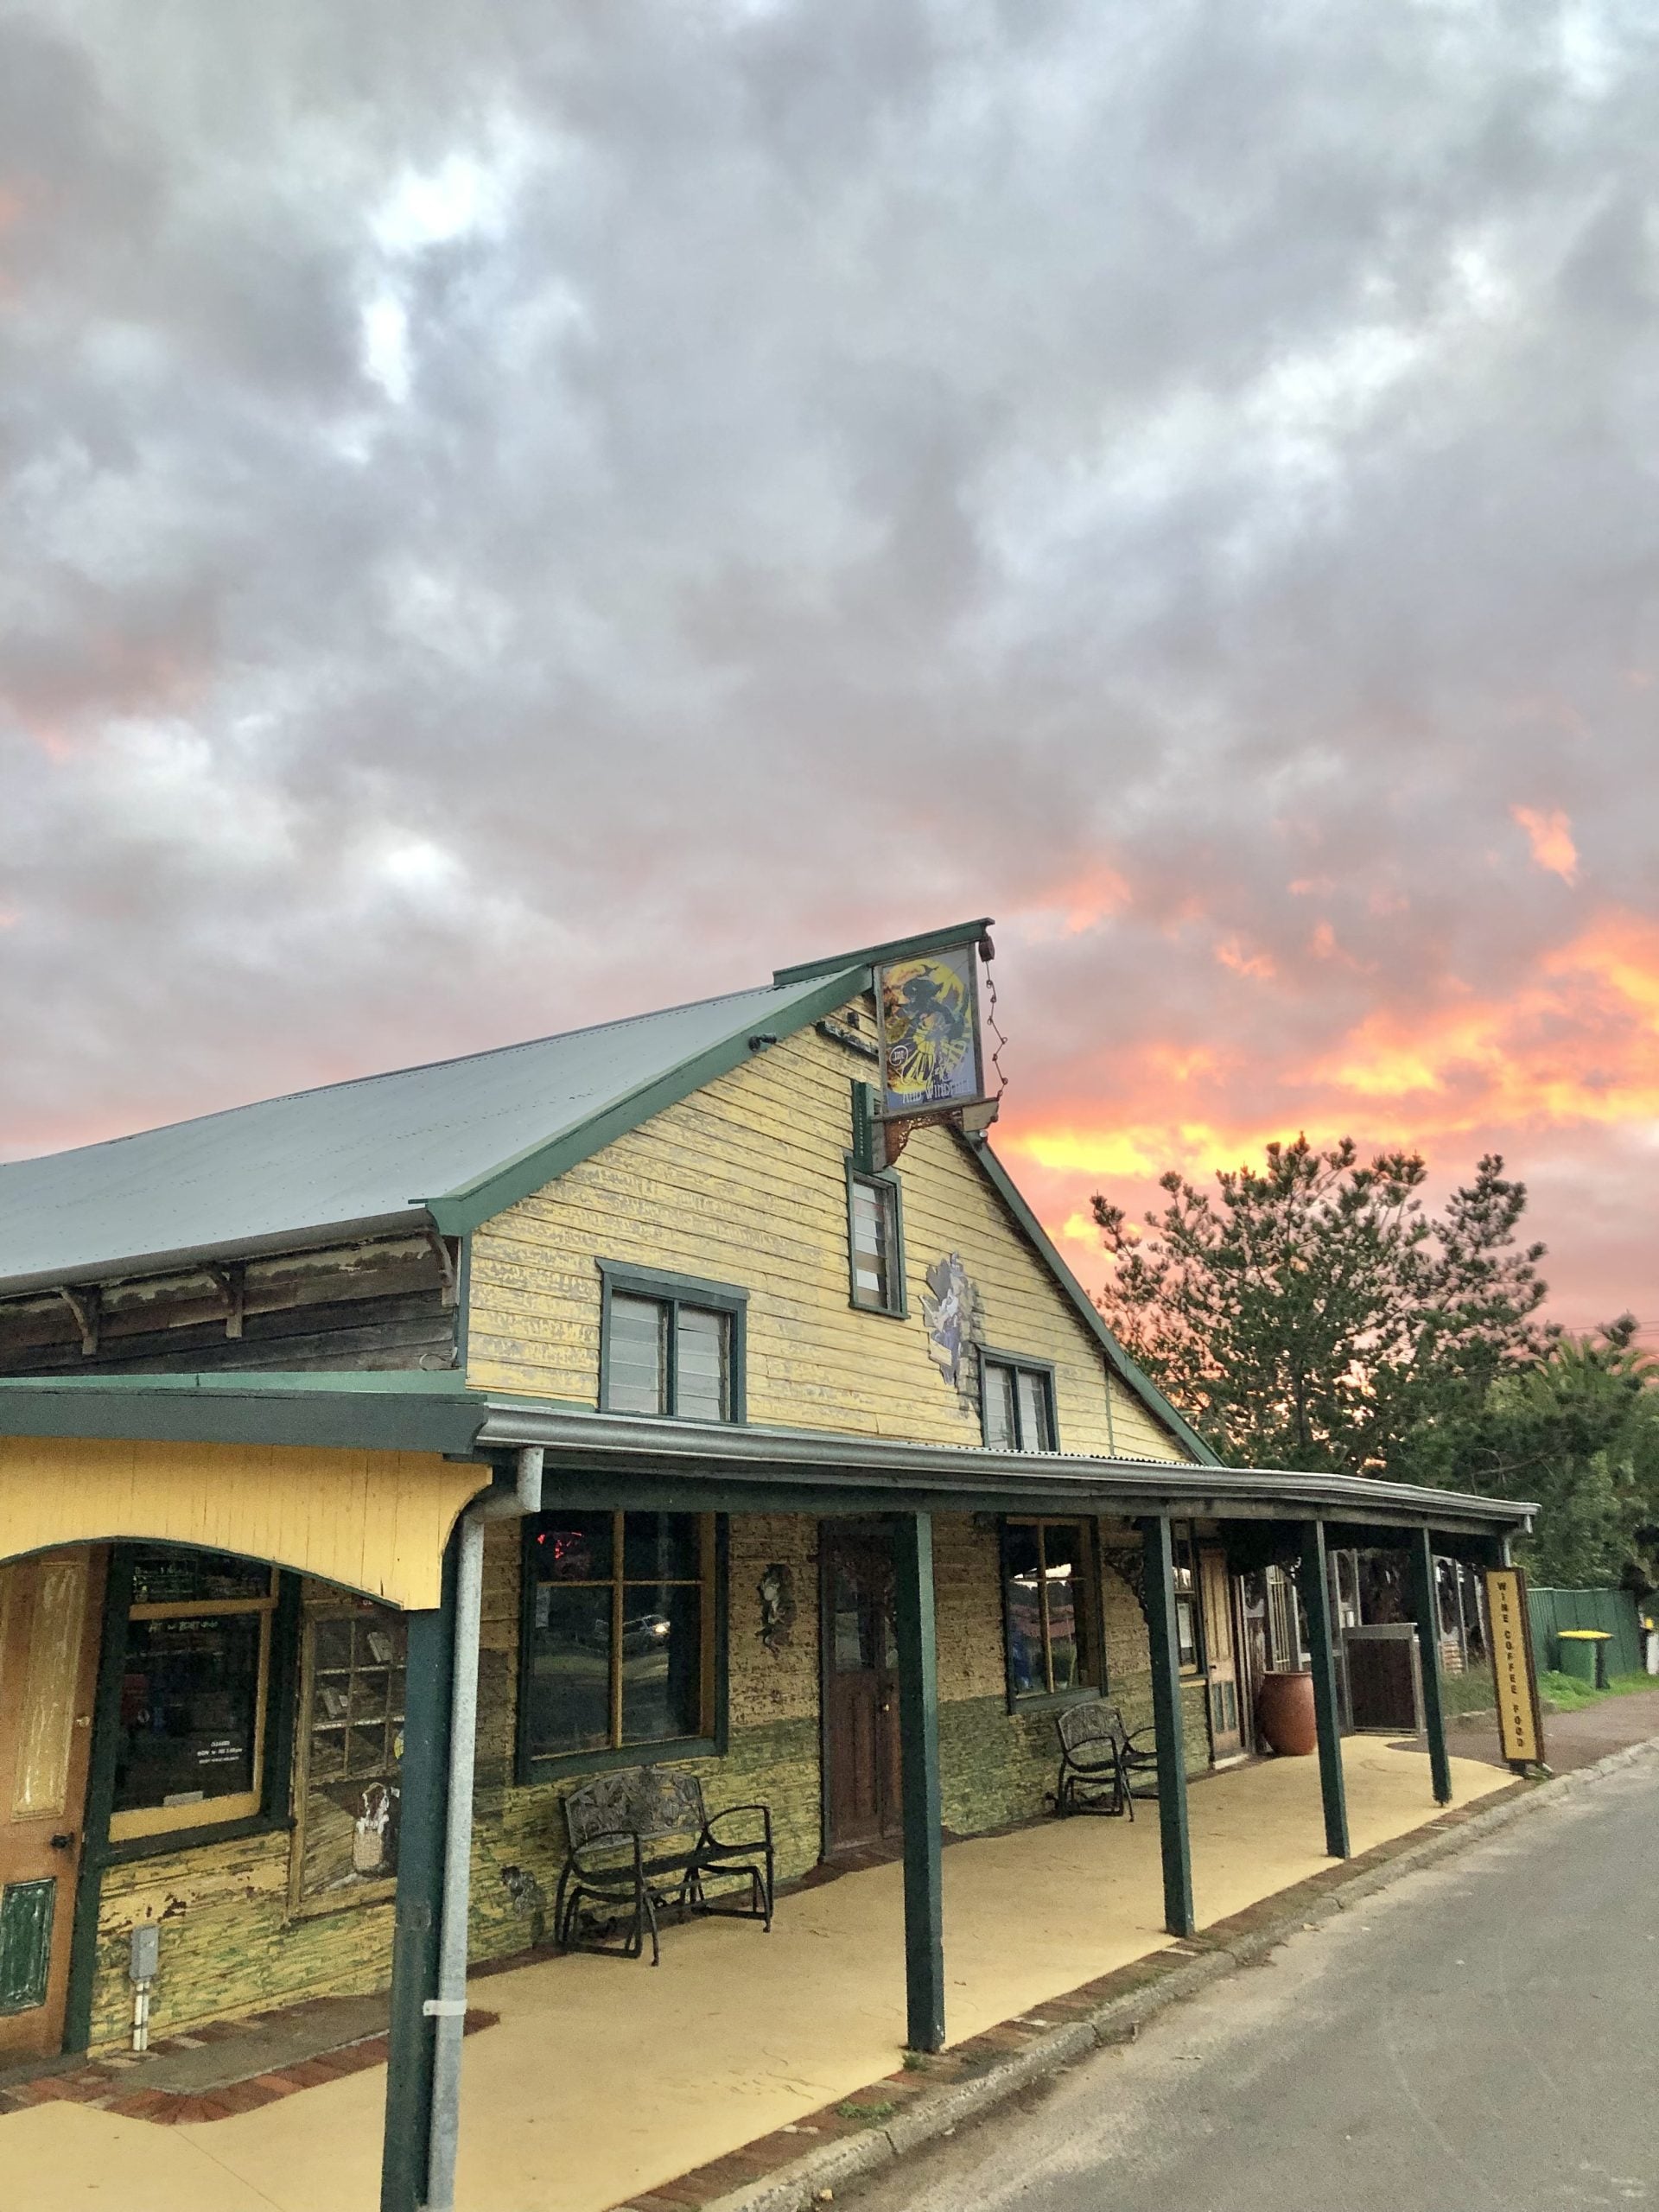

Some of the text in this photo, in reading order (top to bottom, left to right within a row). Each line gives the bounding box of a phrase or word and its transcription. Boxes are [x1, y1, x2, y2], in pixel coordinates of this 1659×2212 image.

[1497, 1582, 1525, 1747] WINE COFFEE FOOD
